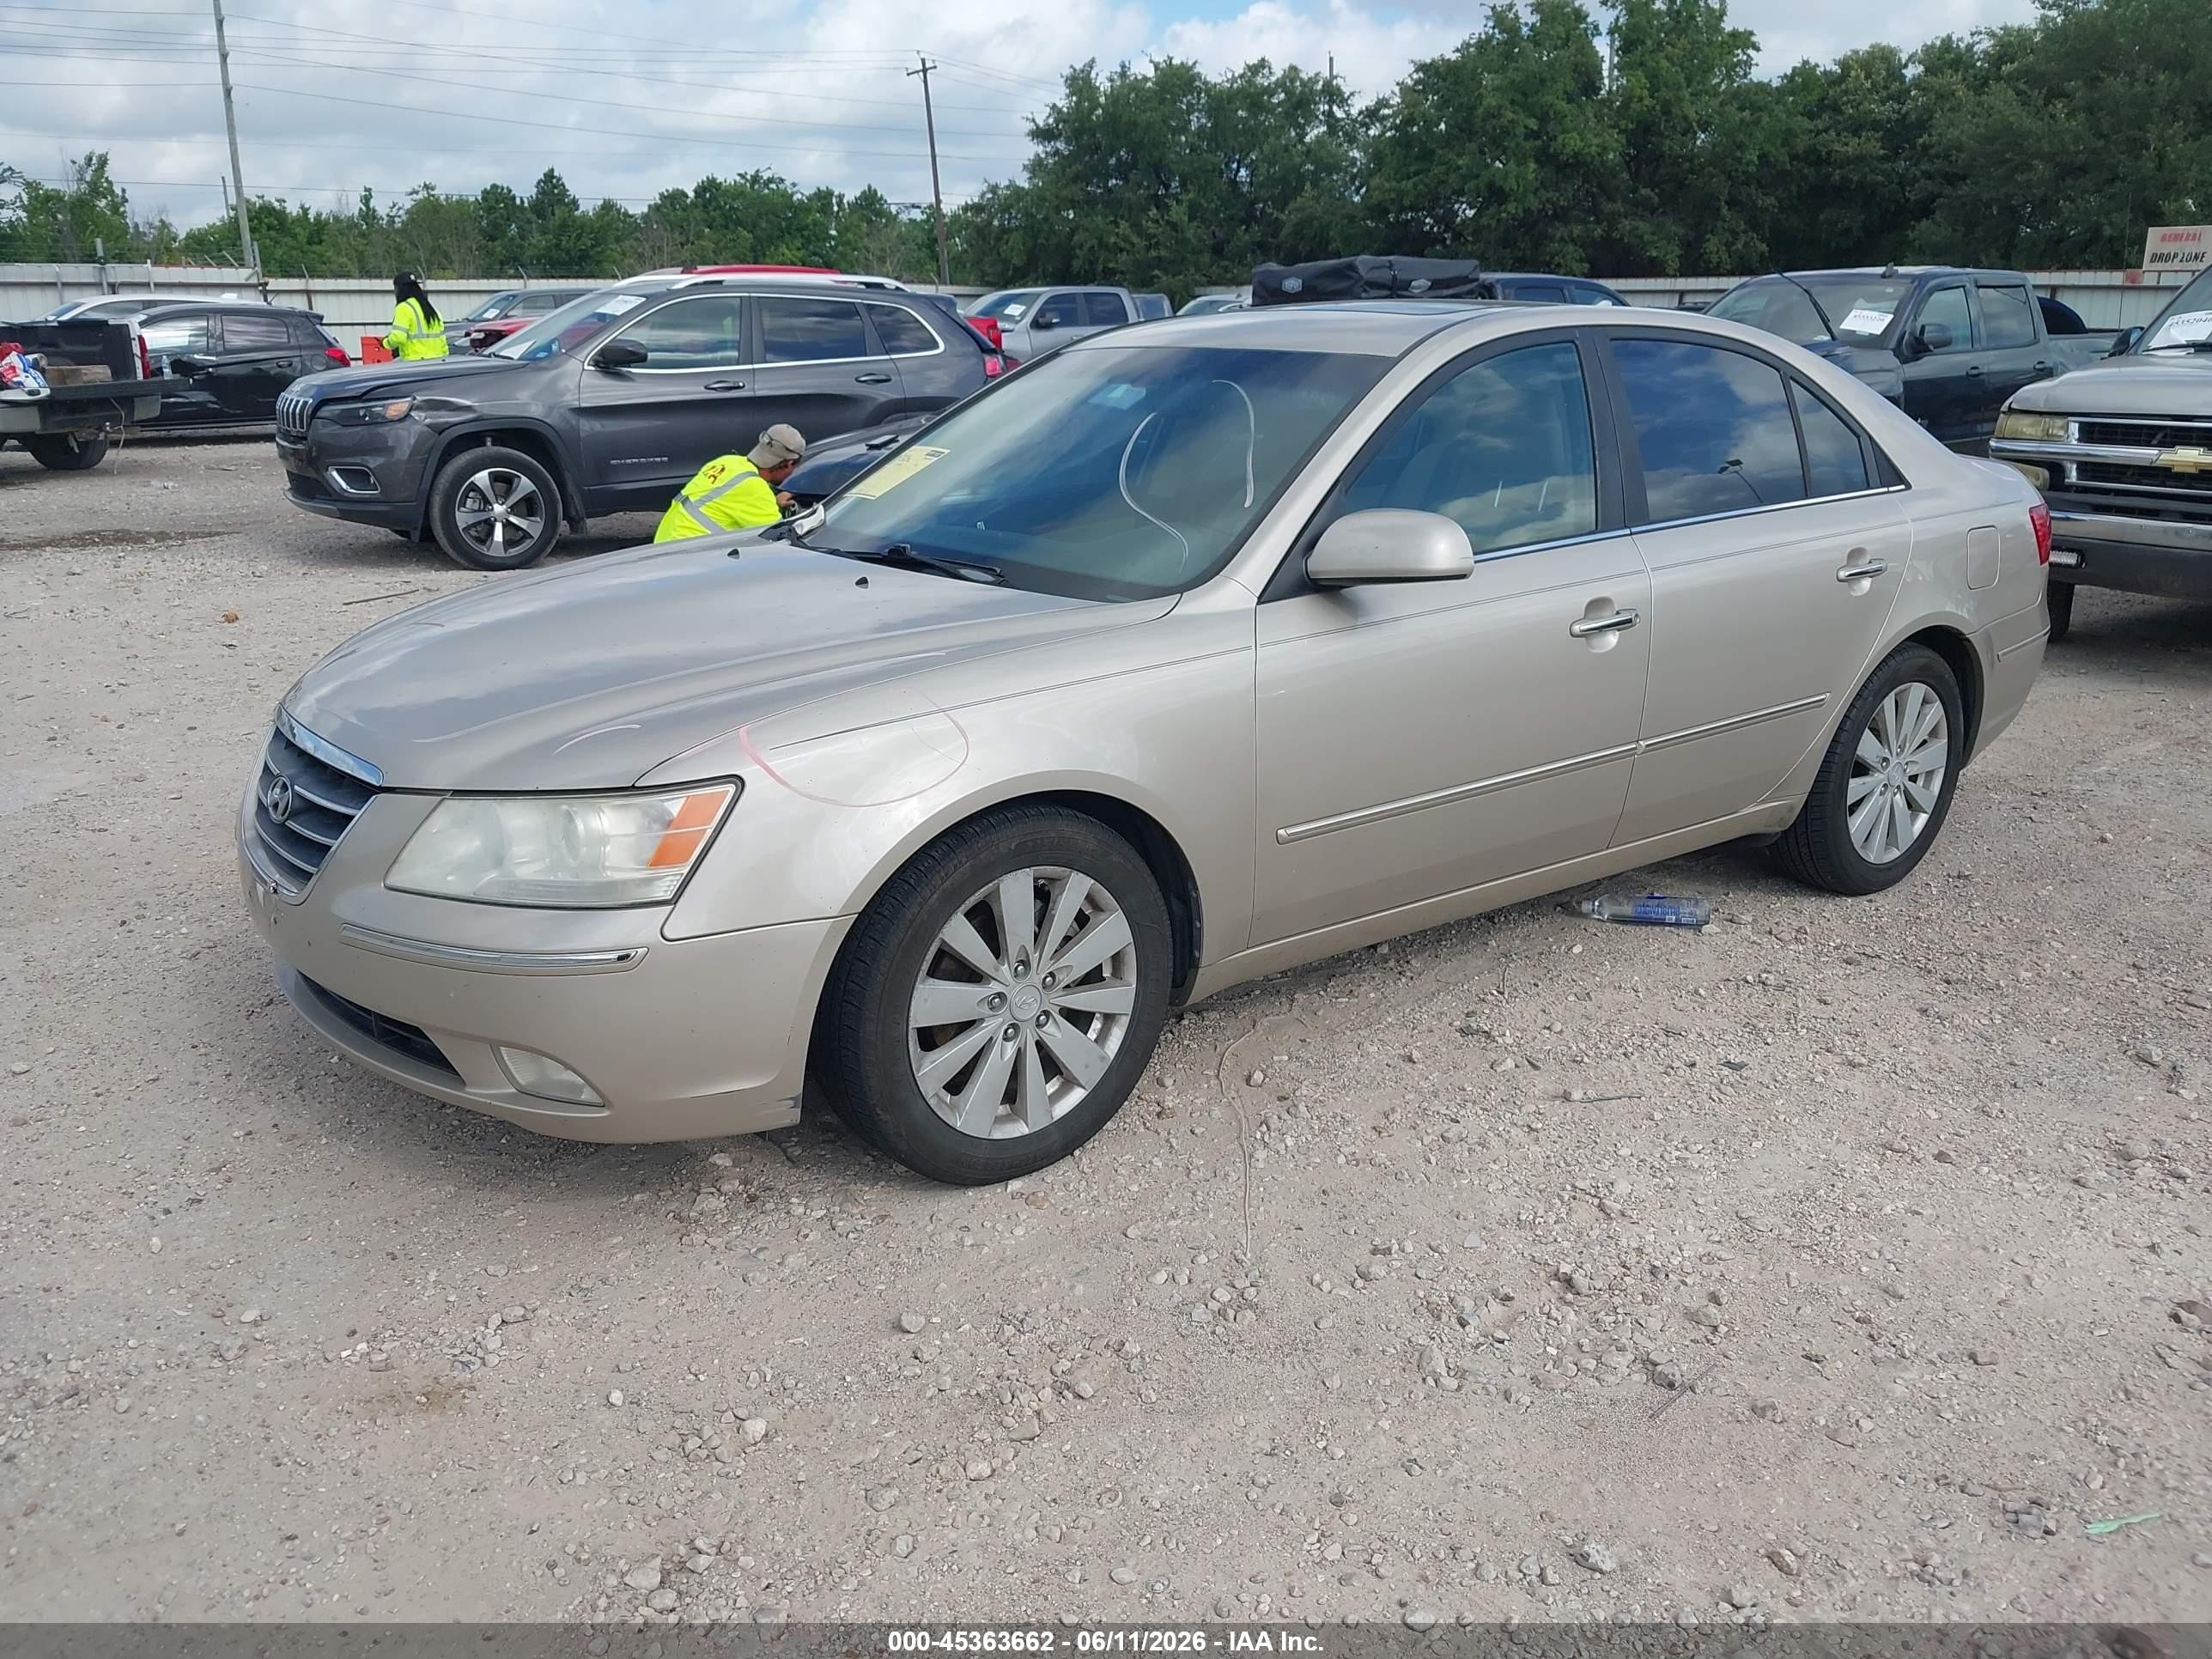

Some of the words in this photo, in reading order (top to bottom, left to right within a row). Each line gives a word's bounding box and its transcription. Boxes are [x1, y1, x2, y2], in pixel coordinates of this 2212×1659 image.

[2160, 233, 2202, 242] GENERAL
[2149, 252, 2179, 263] DROP
[2179, 252, 2207, 263] ZONE
